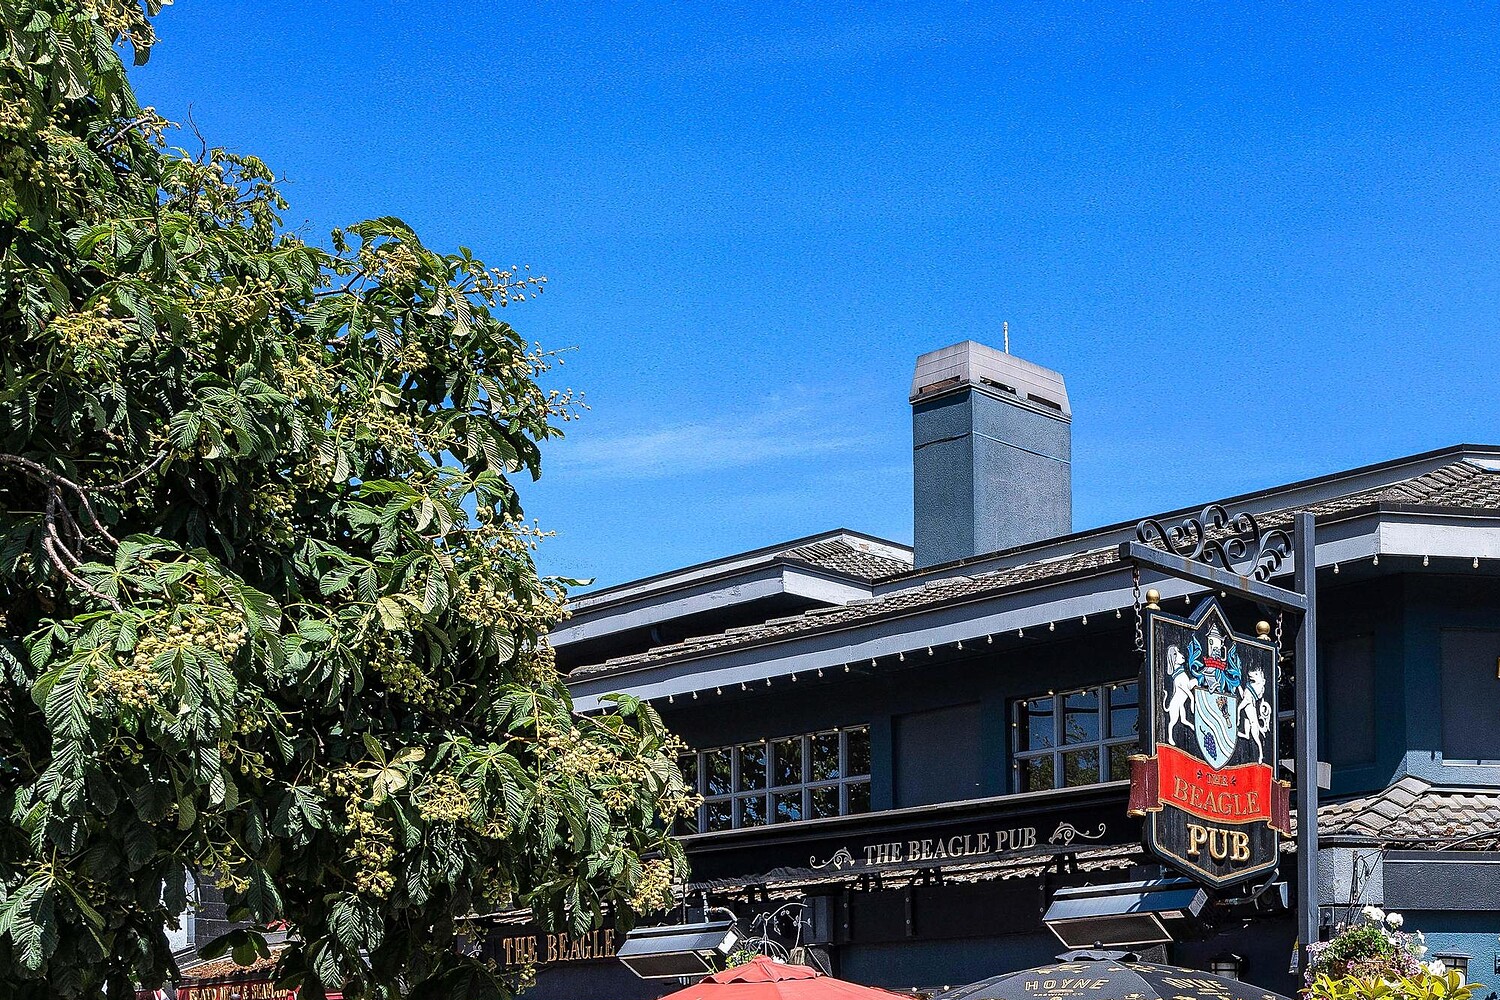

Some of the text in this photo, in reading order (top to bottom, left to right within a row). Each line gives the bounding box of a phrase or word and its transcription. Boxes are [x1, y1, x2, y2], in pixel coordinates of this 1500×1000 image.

[1172, 776, 1260, 816] BEAGLE
[864, 827, 1037, 866] THE BEAGLE PUB
[1187, 823, 1250, 861] PUB
[503, 928, 616, 965] THE BEAGLE
[1026, 978, 1110, 990] HOYNE
